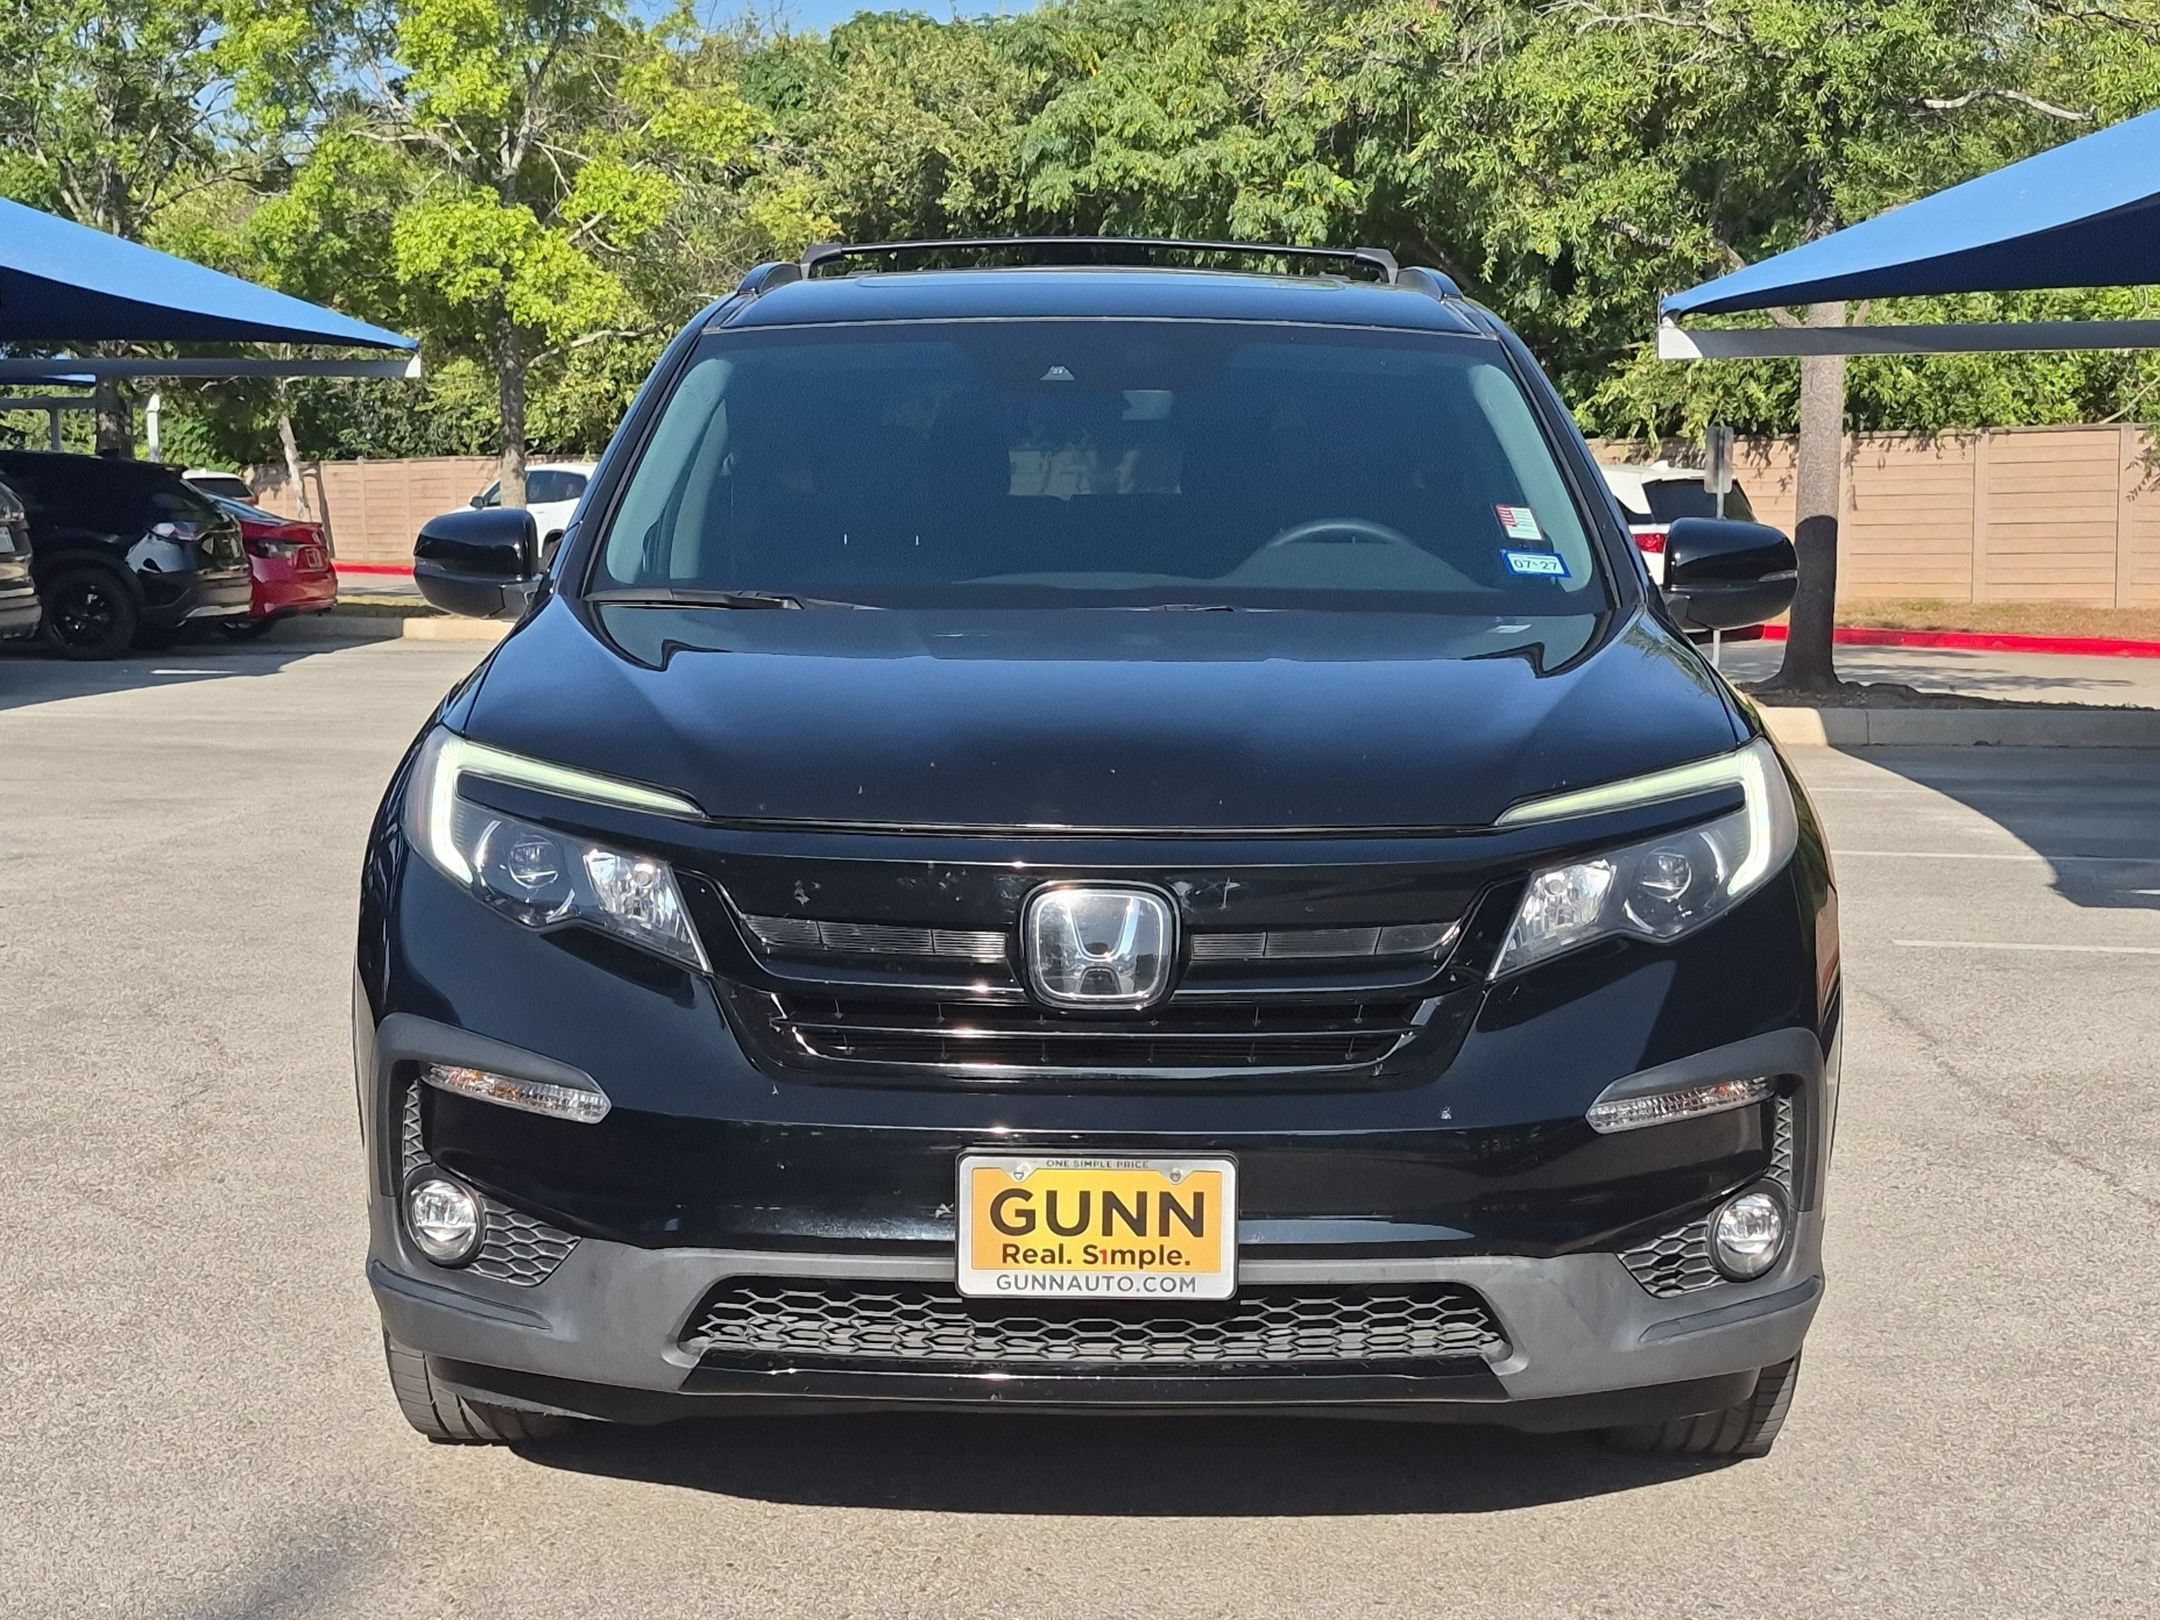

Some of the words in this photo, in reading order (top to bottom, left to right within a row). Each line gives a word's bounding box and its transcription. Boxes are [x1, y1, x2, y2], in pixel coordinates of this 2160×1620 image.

[1046, 1160, 1071, 1168] ONE
[1073, 1160, 1114, 1169] SIMPLE
[1116, 1160, 1150, 1169] PRICE
[989, 1188, 1205, 1238] GUNN
[1002, 1243, 1072, 1265] Real.
[996, 1274, 1197, 1293] GUNNAUTO.COM
